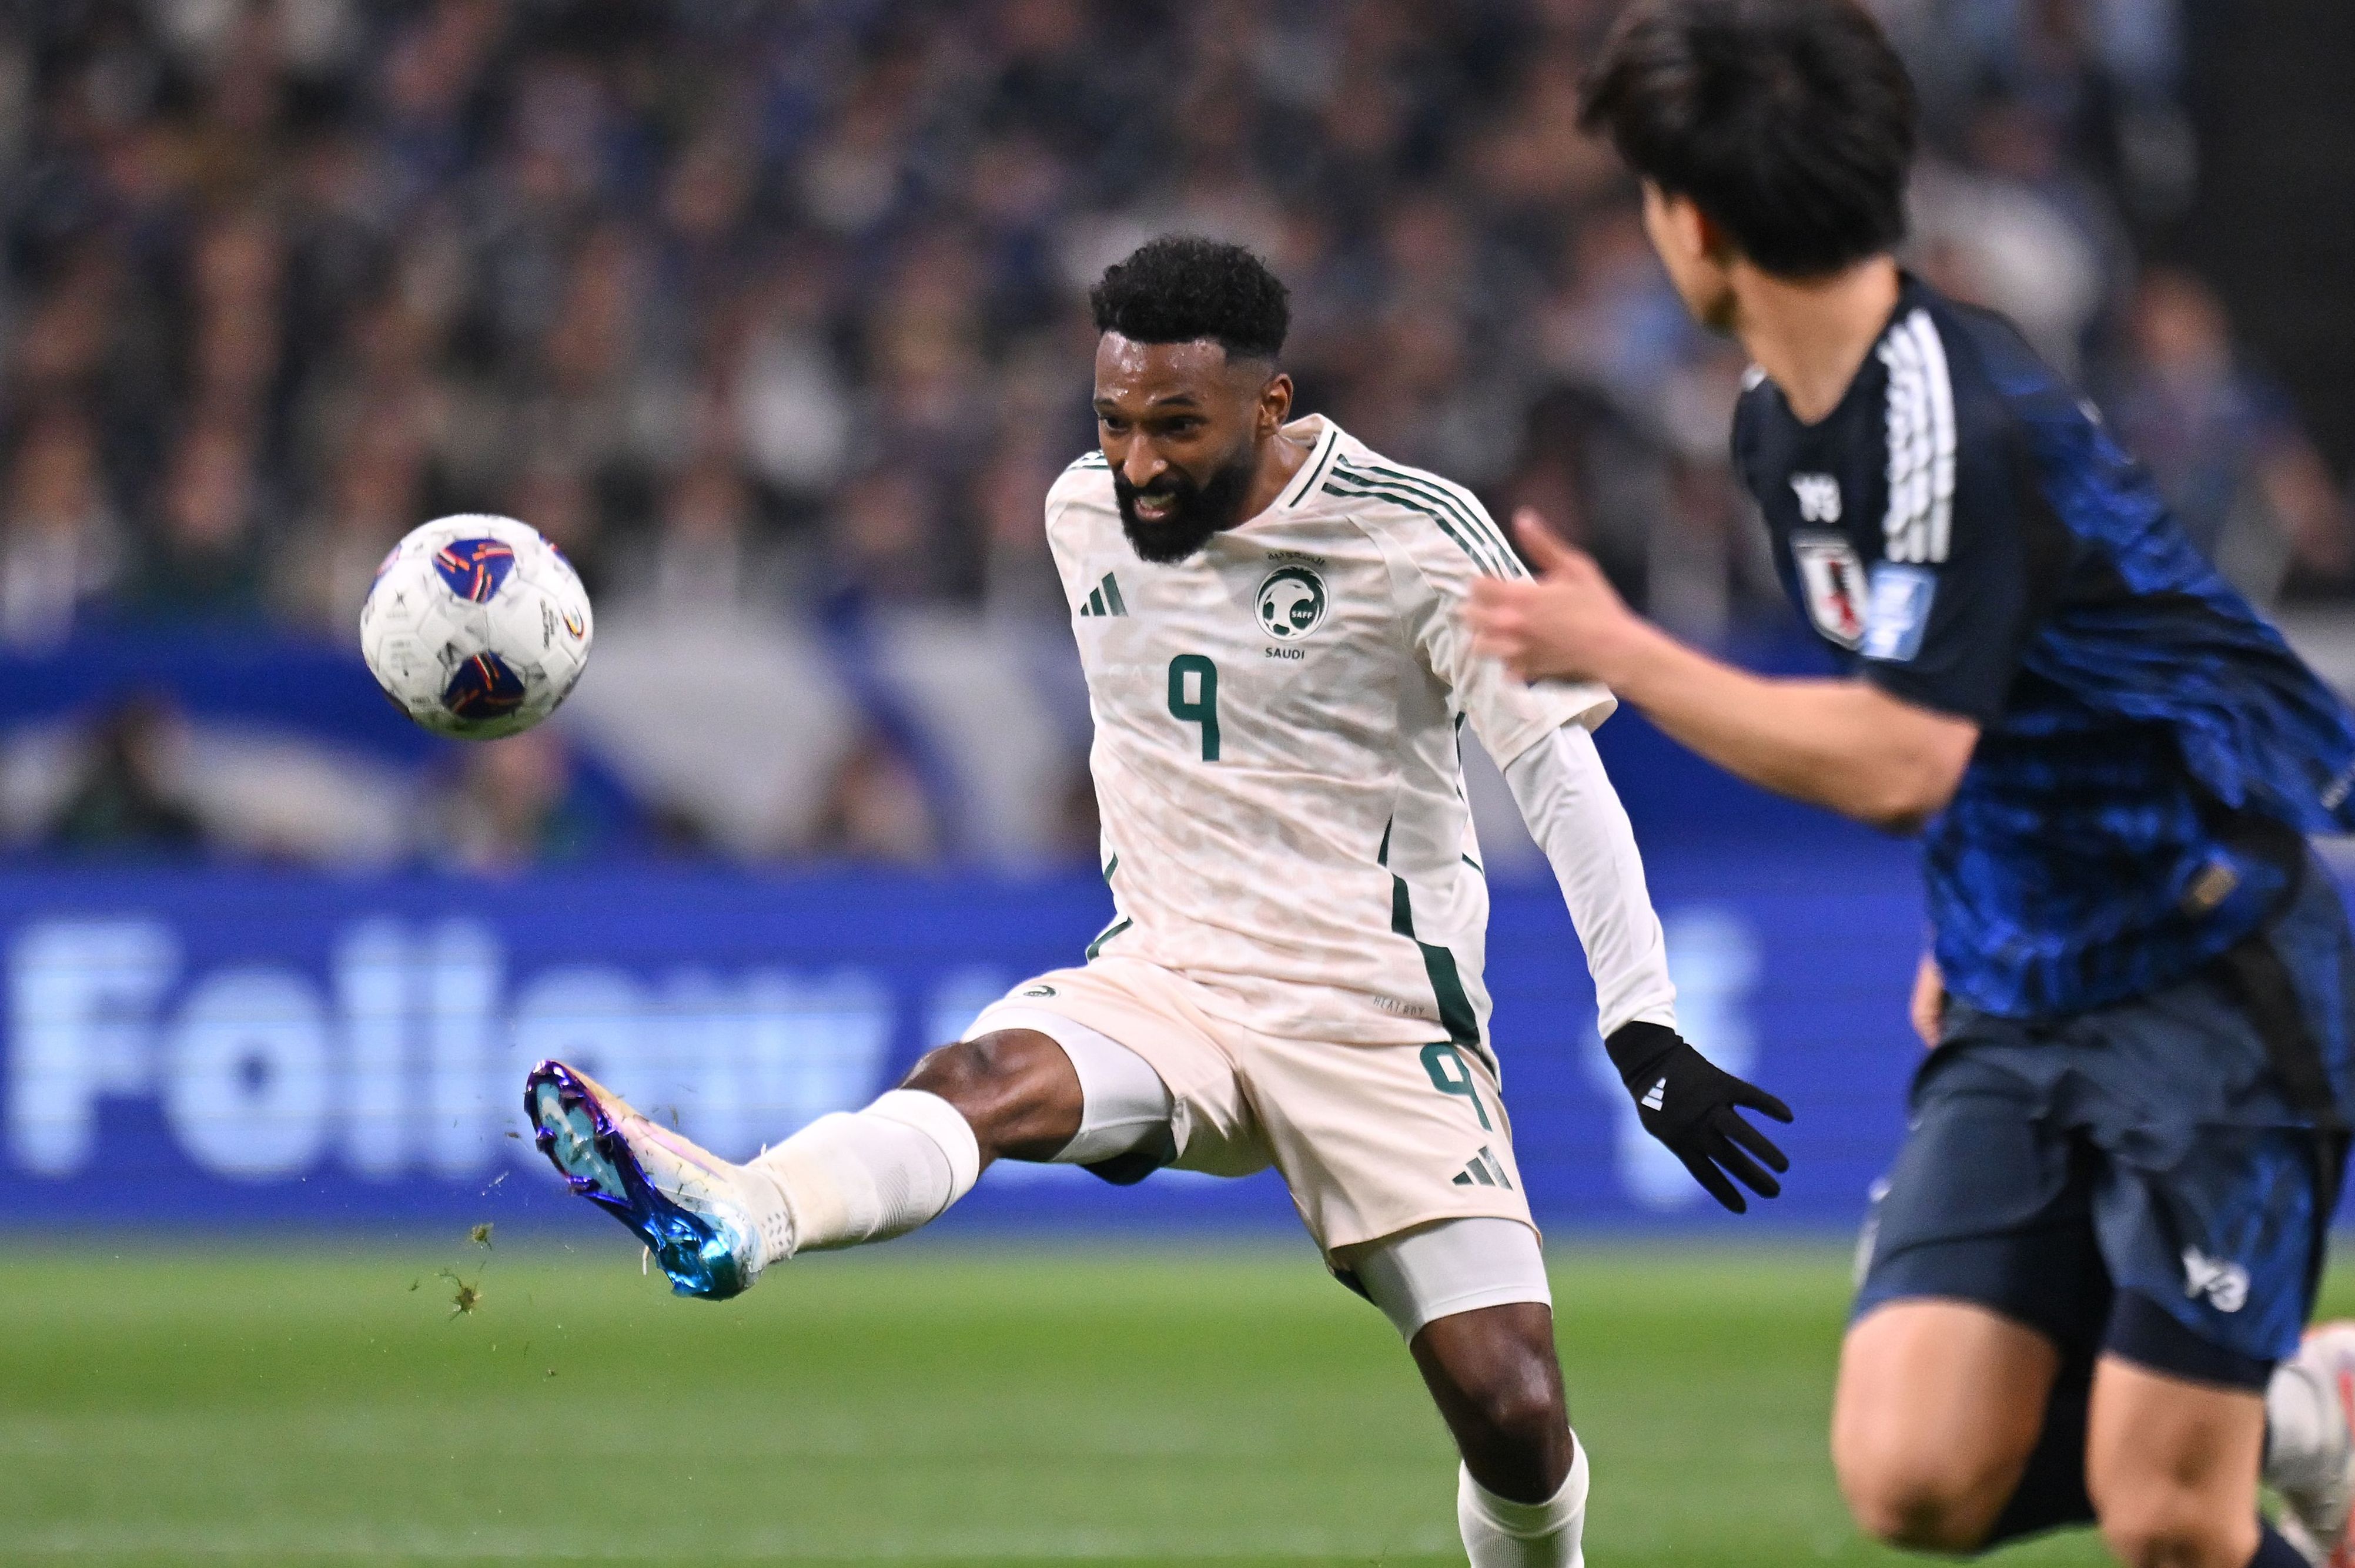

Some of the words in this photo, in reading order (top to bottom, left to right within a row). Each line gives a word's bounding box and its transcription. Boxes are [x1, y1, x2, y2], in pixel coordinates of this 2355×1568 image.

[1265, 647, 1305, 660] SAUDI
[1168, 654, 1220, 762] 9
[9, 918, 892, 1178] Follow
[1419, 1041, 1493, 1133] 9
